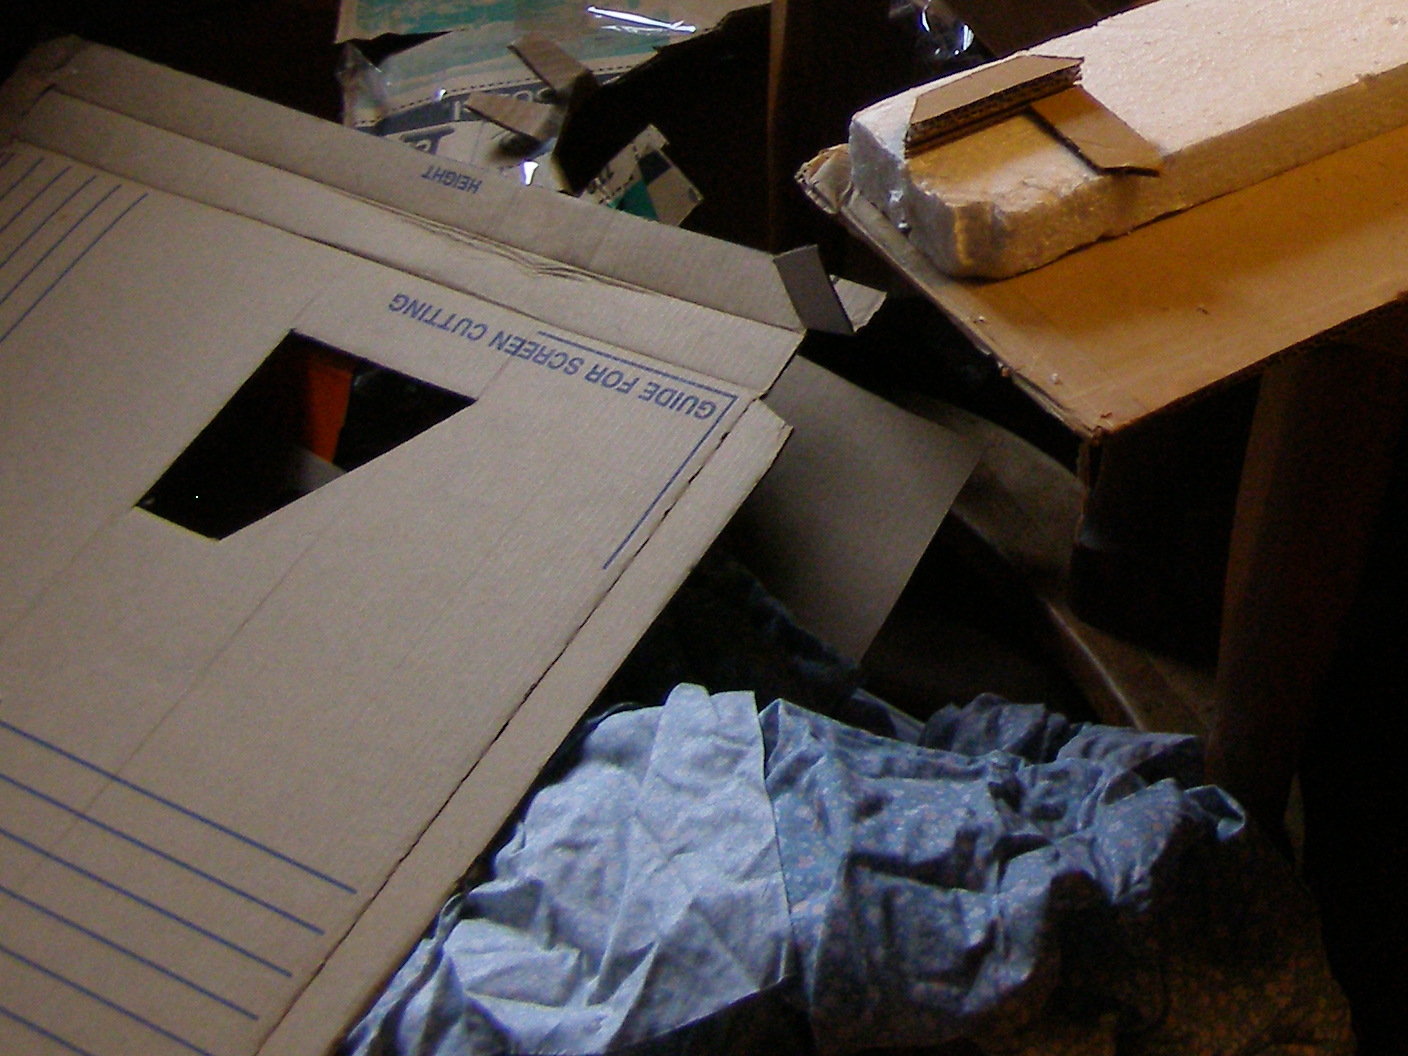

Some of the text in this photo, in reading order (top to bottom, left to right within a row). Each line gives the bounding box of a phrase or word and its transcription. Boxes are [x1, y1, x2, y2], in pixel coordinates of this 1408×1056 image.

[421, 164, 482, 194] HEIGHT
[388, 293, 717, 420] GUIDE FOR SCREEN CUTTING
